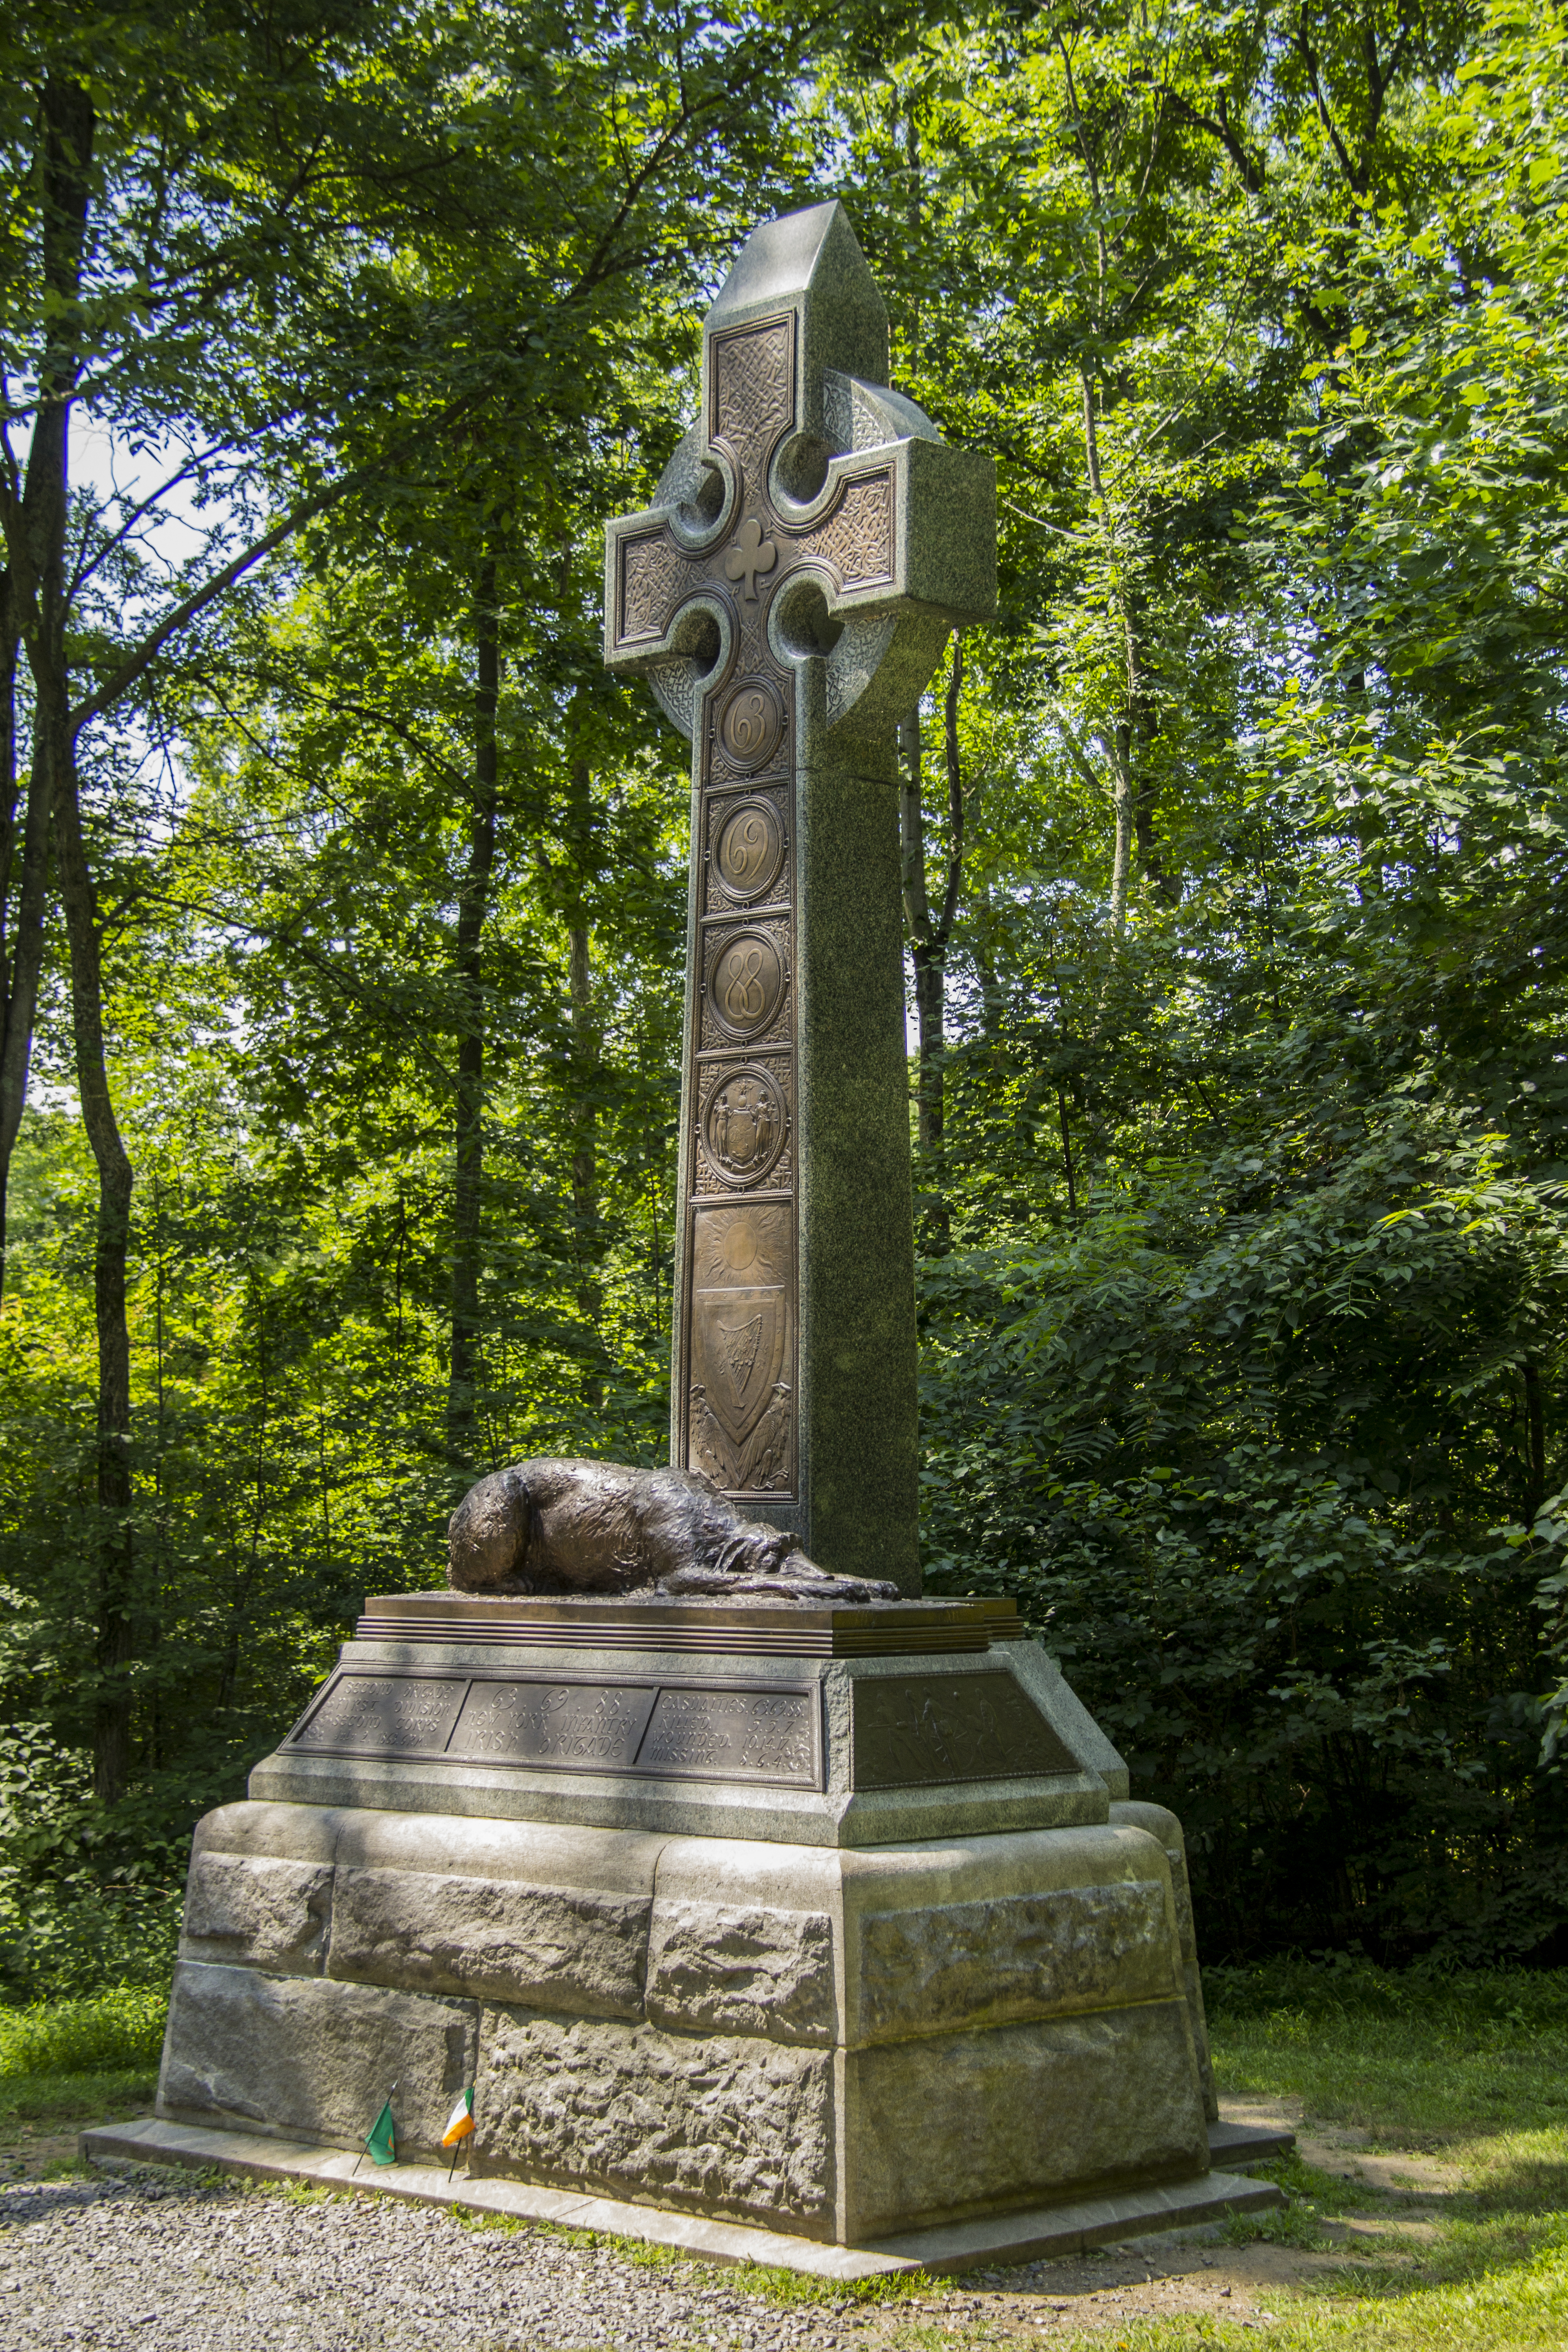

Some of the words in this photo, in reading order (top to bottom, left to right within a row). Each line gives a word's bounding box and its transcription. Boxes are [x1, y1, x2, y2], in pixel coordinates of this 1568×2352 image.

[730, 694, 766, 755] 63
[726, 813, 769, 884] 69
[725, 948, 766, 1021] 88
[344, 1681, 394, 1695] SECOND
[336, 1697, 380, 1711] FIRST
[394, 1701, 451, 1716] DIVISION
[662, 1695, 748, 1714] CASUALTIES.
[332, 1714, 382, 1728] SECOND
[396, 1717, 440, 1732] CORPS
[465, 1710, 502, 1726] NEW
[508, 1712, 549, 1730] YORK
[561, 1714, 637, 1735] INFANTRY
[658, 1714, 712, 1730] KILLED.
[653, 1730, 731, 1748] WOUNDED.
[650, 1746, 718, 1765] MISSING.
